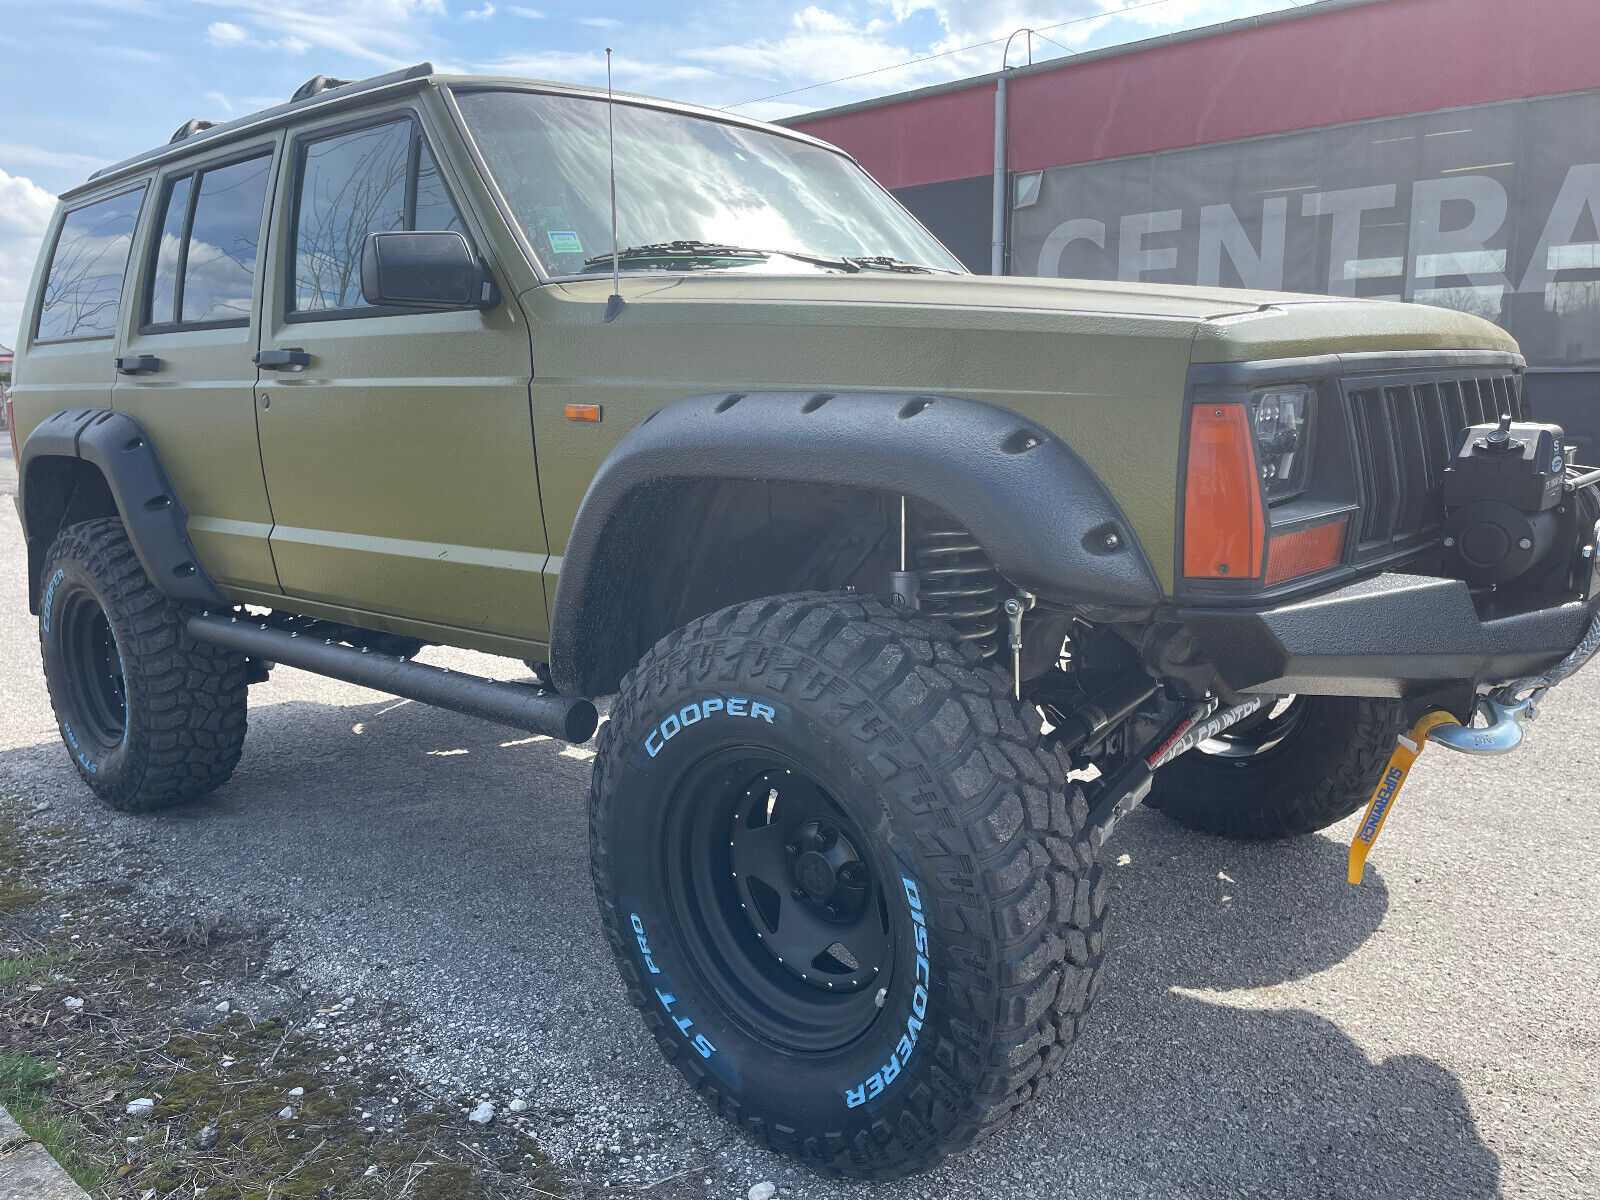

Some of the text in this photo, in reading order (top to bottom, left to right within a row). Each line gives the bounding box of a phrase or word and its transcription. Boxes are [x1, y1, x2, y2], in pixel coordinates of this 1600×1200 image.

[44, 568, 65, 633] COOPER
[645, 698, 776, 758] COOPER
[1358, 766, 1403, 843] SUPERWINCH
[630, 912, 717, 1059] STT PRO
[845, 877, 930, 1109] DISCOVERER
